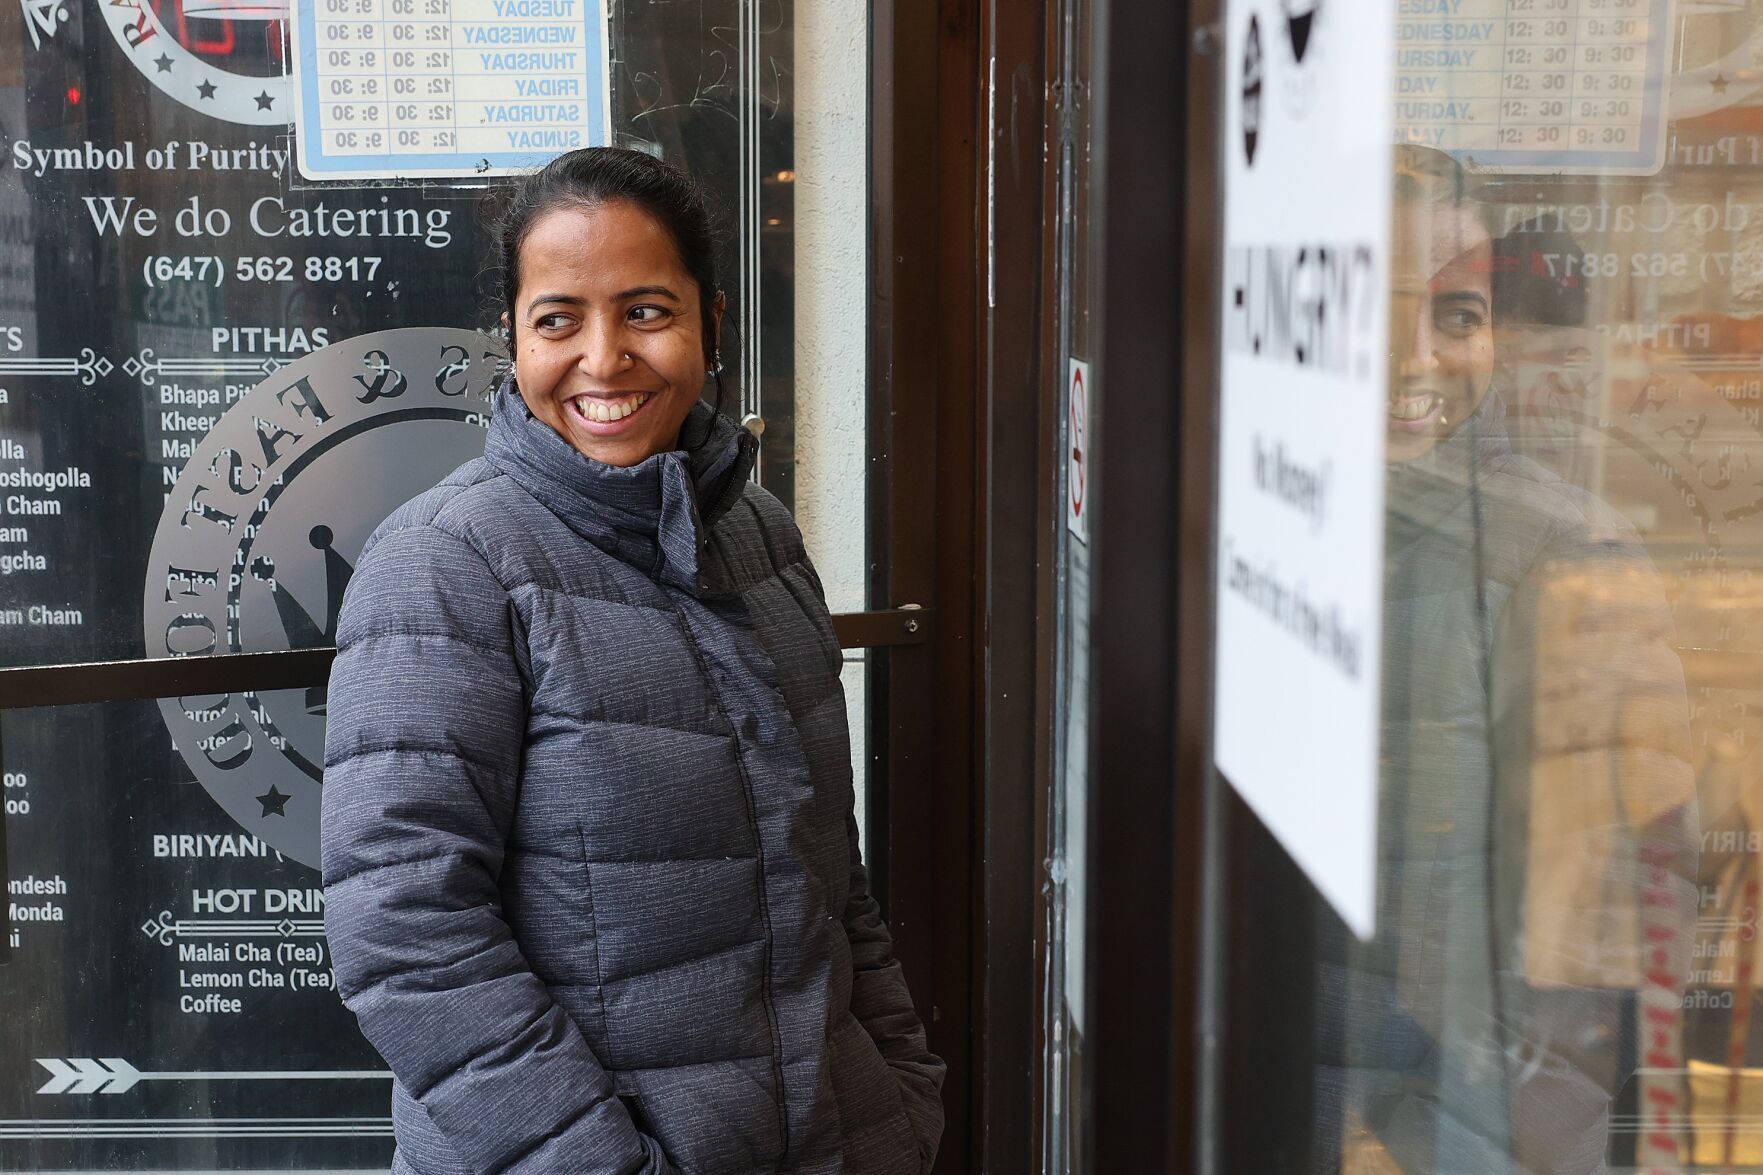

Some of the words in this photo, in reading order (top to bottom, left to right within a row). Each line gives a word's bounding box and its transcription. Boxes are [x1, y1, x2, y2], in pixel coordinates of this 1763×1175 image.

[1507, 21, 1532, 37] 12:
[1544, 21, 1567, 36] 30
[1507, 48, 1531, 64] 12:
[1544, 47, 1566, 63] 30
[1585, 47, 1601, 62] 9:
[1611, 46, 1634, 62] 30
[1504, 74, 1529, 90] 12:
[1542, 74, 1565, 90] 30
[1582, 75, 1599, 91] 9:
[1608, 74, 1632, 91] 30
[1502, 101, 1527, 117] 12:
[1539, 101, 1562, 116] 30
[1581, 101, 1597, 117] 9:
[1606, 101, 1629, 116] 30
[1536, 127, 1560, 142] 30
[1577, 128, 1594, 144] 9:
[1602, 127, 1626, 143] 30
[13, 140, 135, 178] Symbol
[145, 141, 180, 170] of
[187, 141, 288, 178] Purity
[82, 196, 158, 237] We
[175, 196, 231, 237] do
[250, 195, 452, 248] Catering
[143, 256, 224, 288] (647)
[236, 256, 294, 282] 562
[305, 256, 382, 281] 8817
[212, 327, 329, 353] PITHAS
[160, 384, 220, 408] Bhapa
[161, 411, 216, 431] Kheer
[6, 494, 61, 515] Cham
[28, 605, 83, 625] Cham
[154, 834, 267, 858] BIRIYANI
[193, 889, 257, 913] HOT
[179, 942, 230, 962] Malai
[235, 942, 272, 962] Cha
[277, 942, 324, 966] (Tea)
[180, 968, 243, 988] Lemon
[249, 967, 285, 988] Cha
[290, 967, 336, 992] (Tea)
[180, 993, 242, 1013] Coffee
